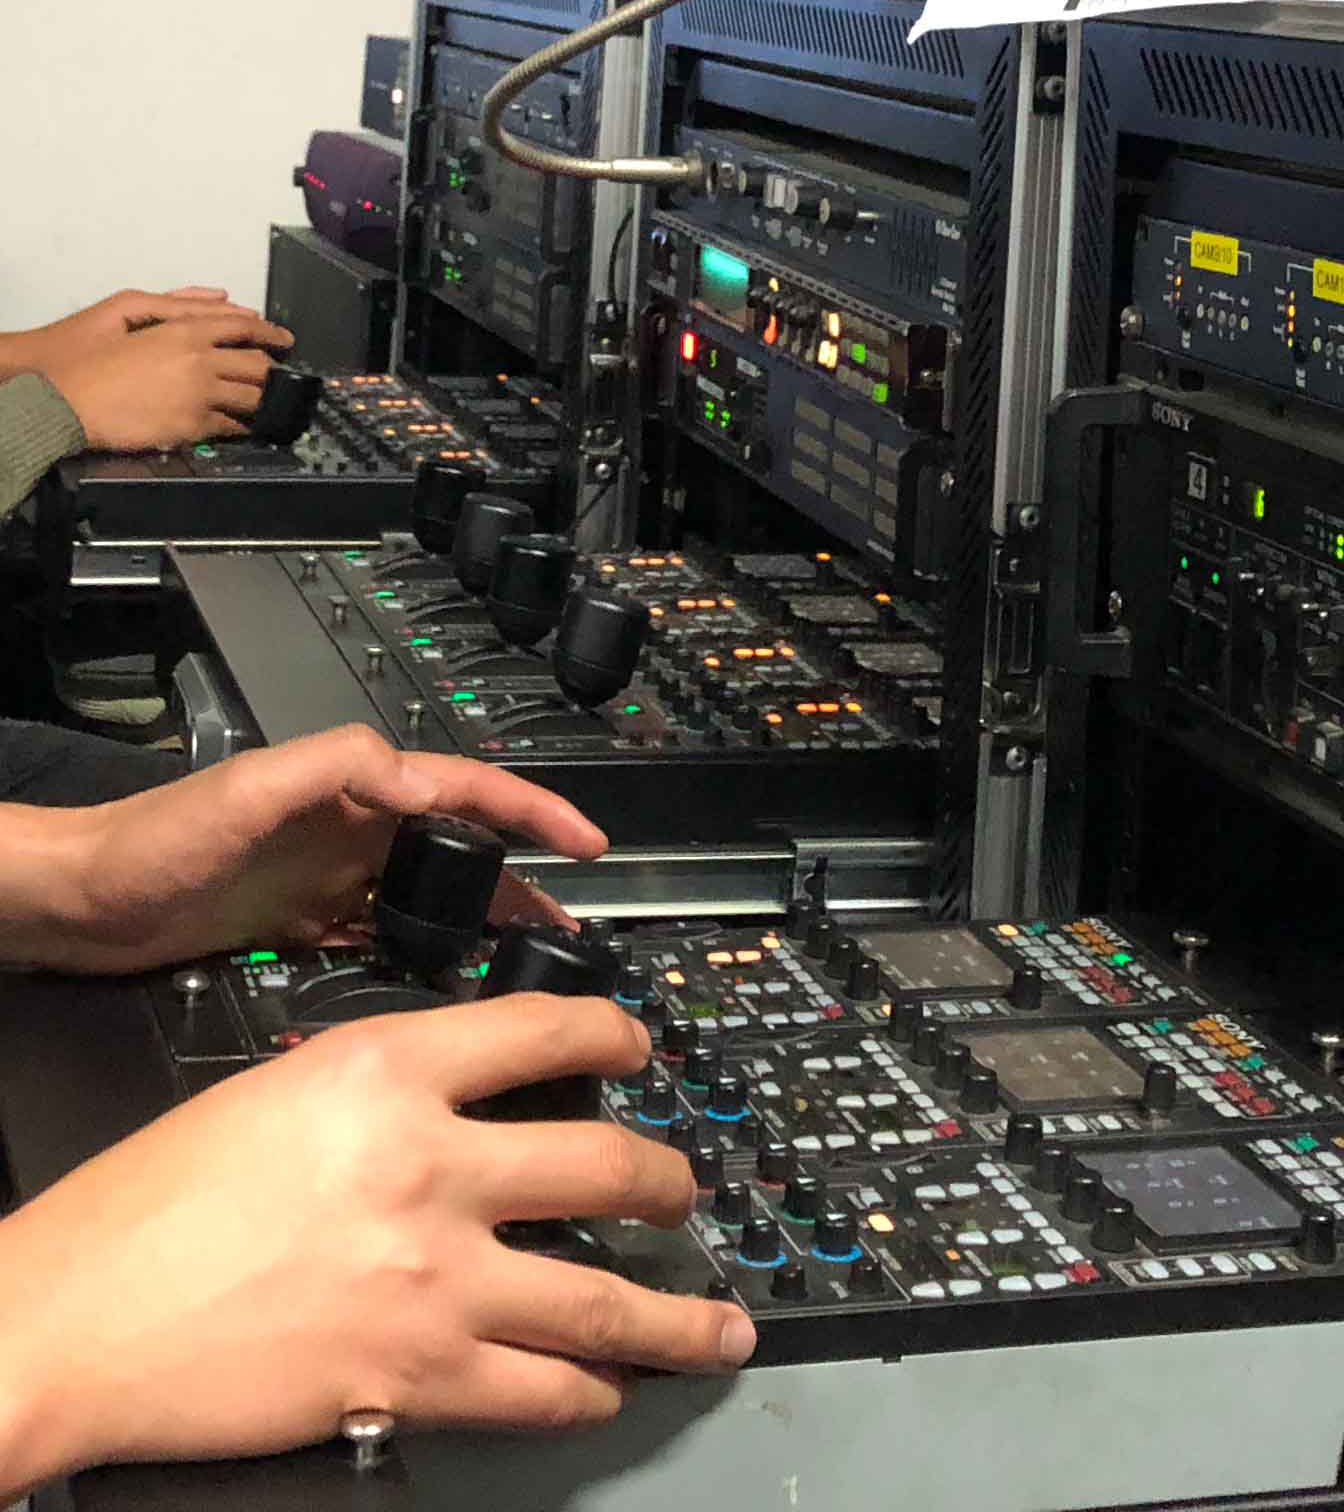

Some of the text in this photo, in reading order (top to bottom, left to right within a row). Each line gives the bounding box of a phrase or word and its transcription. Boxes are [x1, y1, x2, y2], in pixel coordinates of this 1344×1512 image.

[1151, 402, 1194, 432] SONY
[1081, 917, 1135, 949] SONY
[1206, 1013, 1266, 1049] SONY
